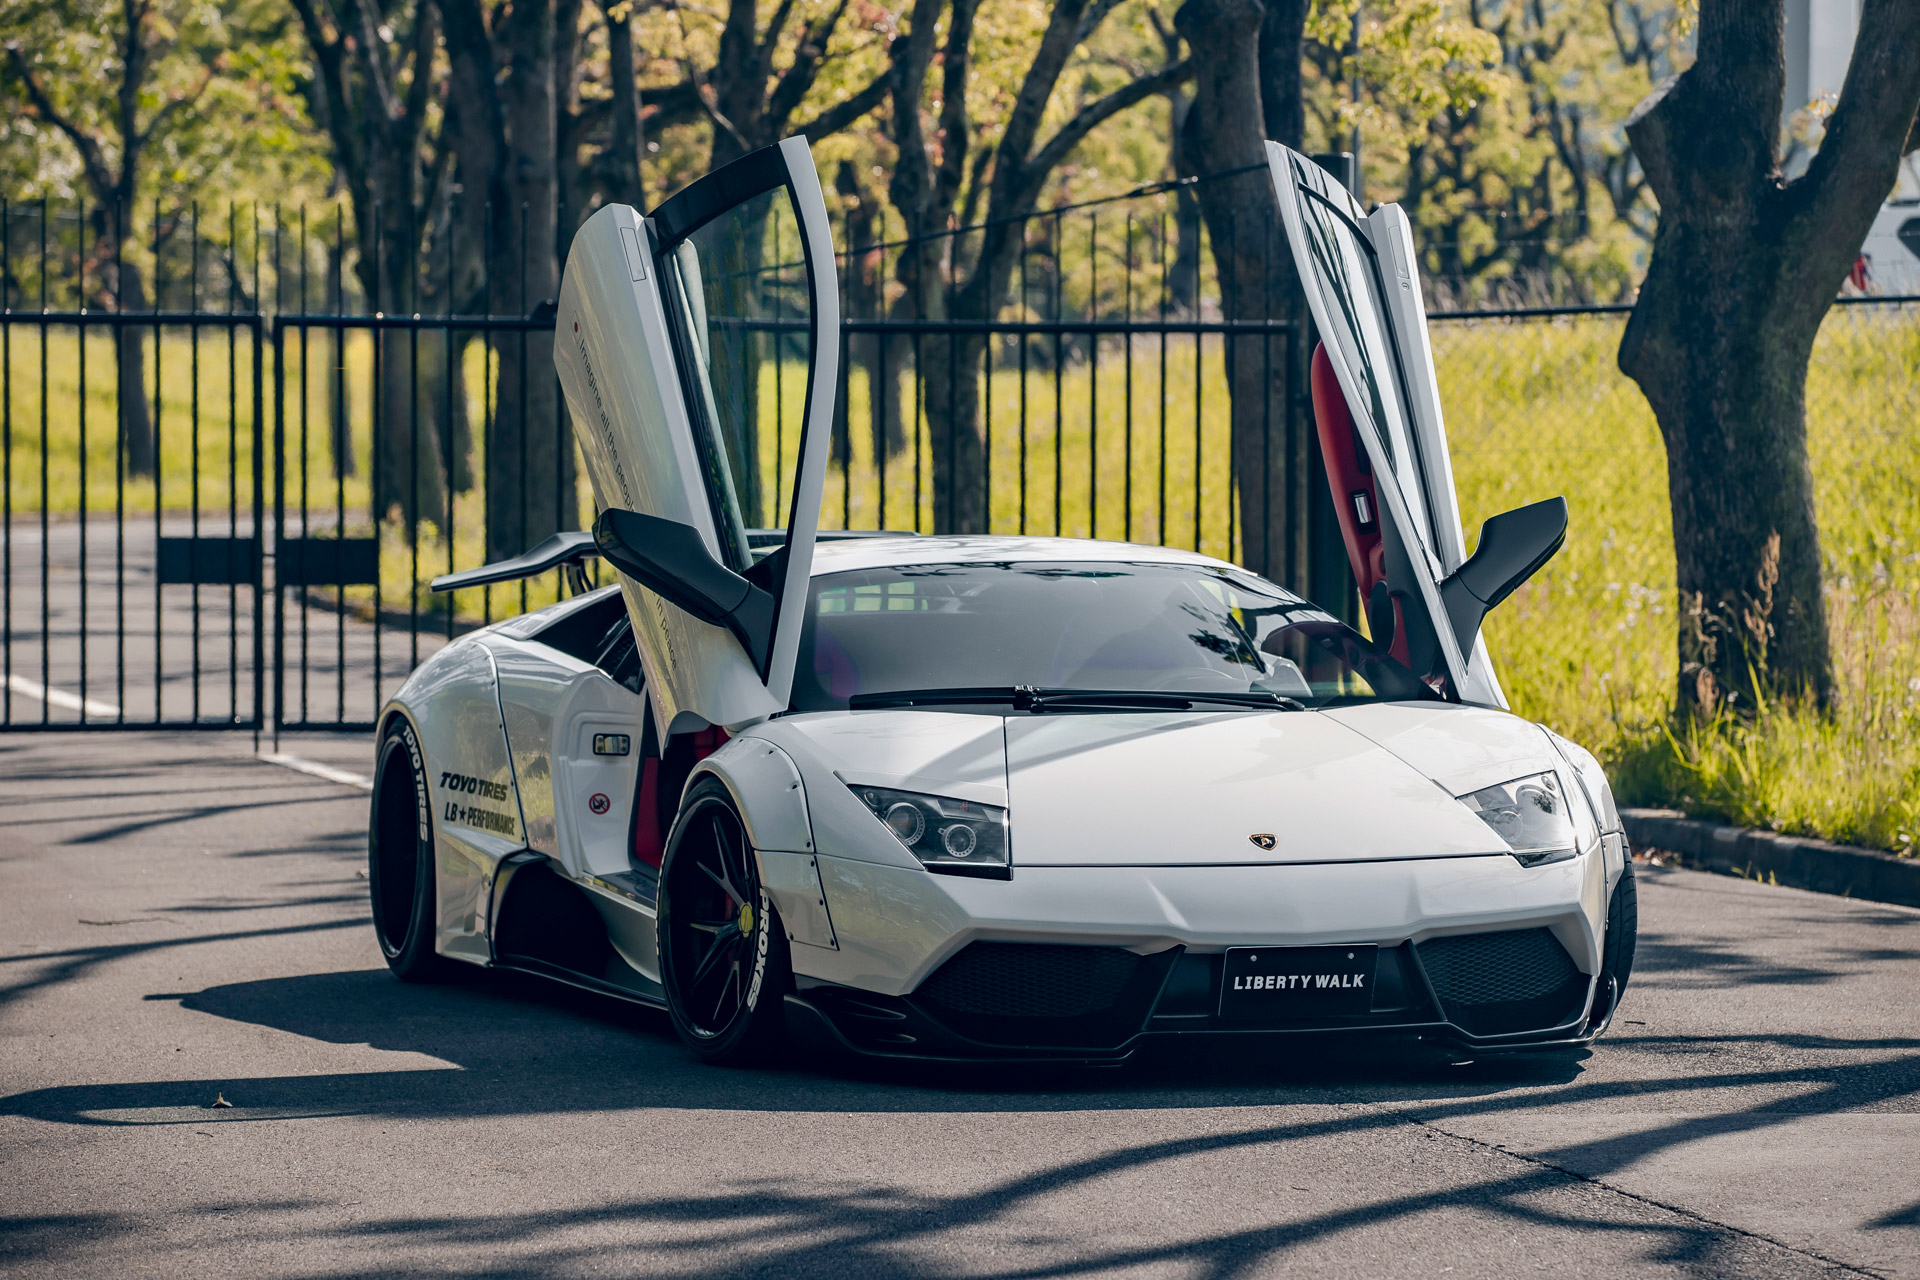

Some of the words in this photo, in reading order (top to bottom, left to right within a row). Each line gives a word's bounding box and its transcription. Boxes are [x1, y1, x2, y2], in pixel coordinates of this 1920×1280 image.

[580, 338, 602, 409] Imagine
[601, 411, 610, 432] all
[608, 432, 618, 461] the
[656, 598, 663, 616] in
[660, 617, 677, 671] peace
[403, 725, 421, 770] TOYO
[416, 770, 428, 842] TIRES
[440, 771, 478, 794] TOYO
[478, 779, 508, 801] TIRES
[467, 807, 515, 836] PERFORMANCE
[747, 887, 769, 1012] PROXES
[1234, 975, 1311, 990] LIBERTY
[1315, 974, 1365, 988] WALK
